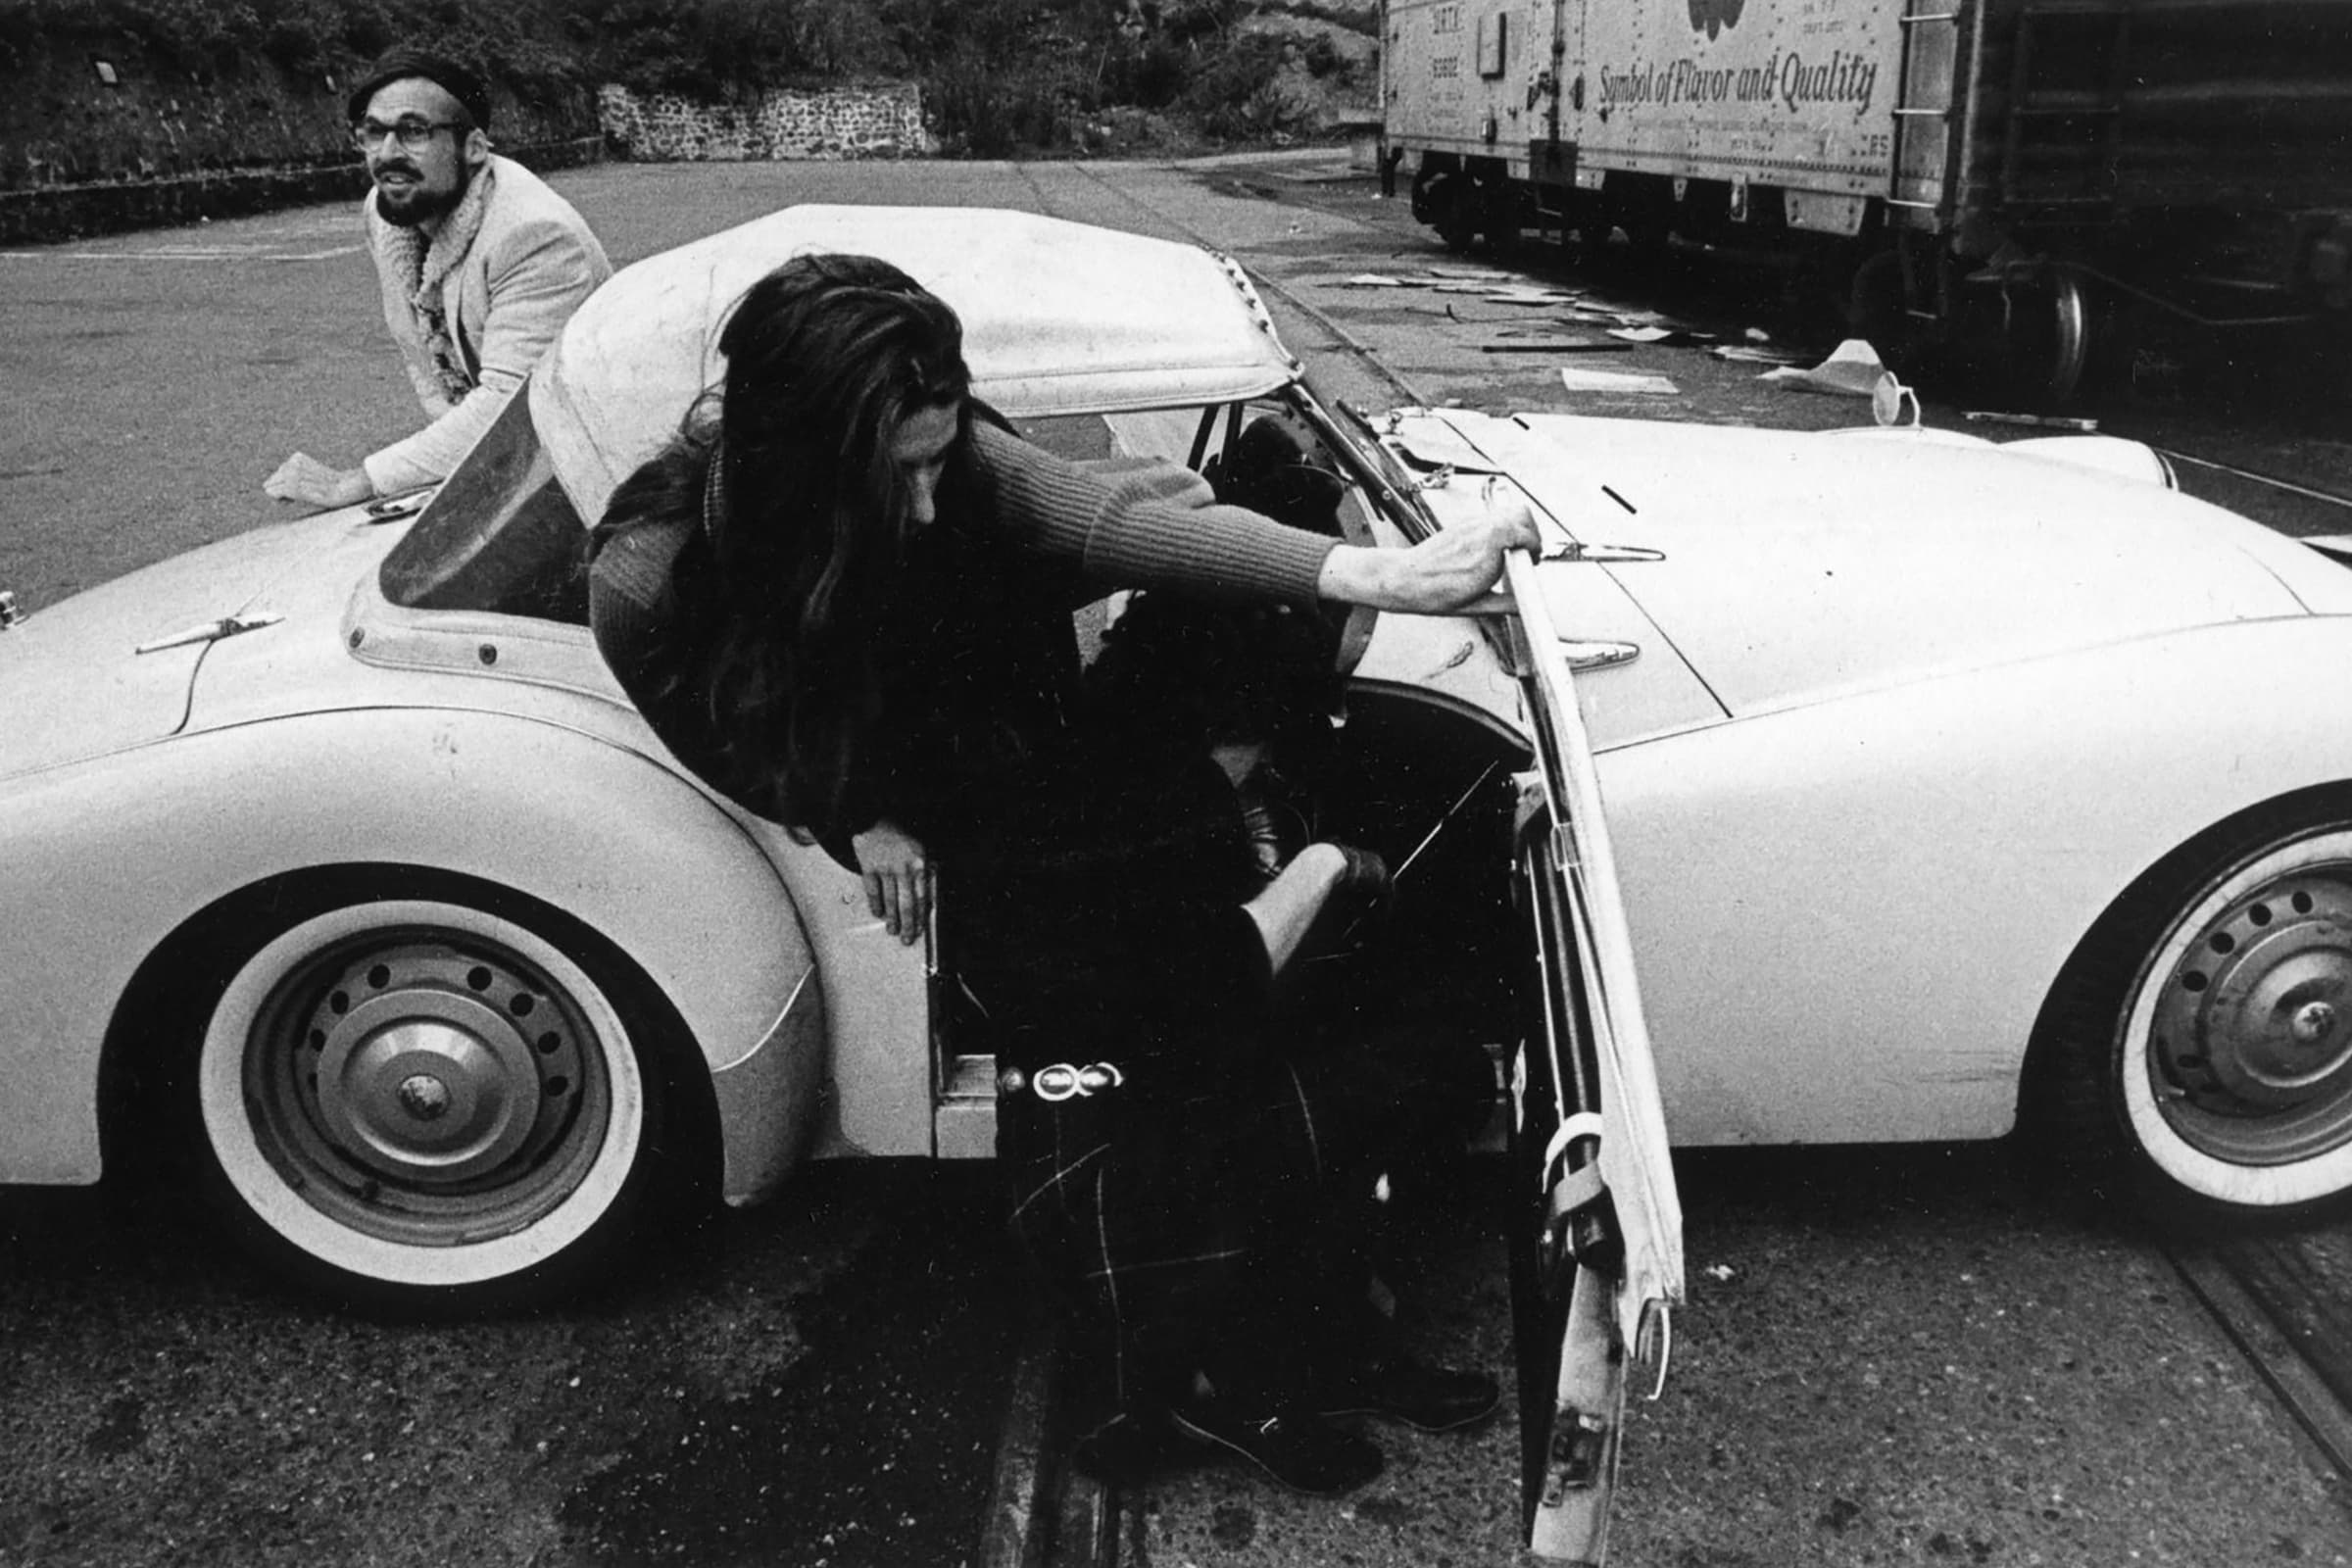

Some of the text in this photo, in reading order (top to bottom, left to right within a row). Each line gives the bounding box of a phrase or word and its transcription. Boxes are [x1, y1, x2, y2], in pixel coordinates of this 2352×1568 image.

[1599, 50, 1878, 116] Symbol of Flavor and Quality
